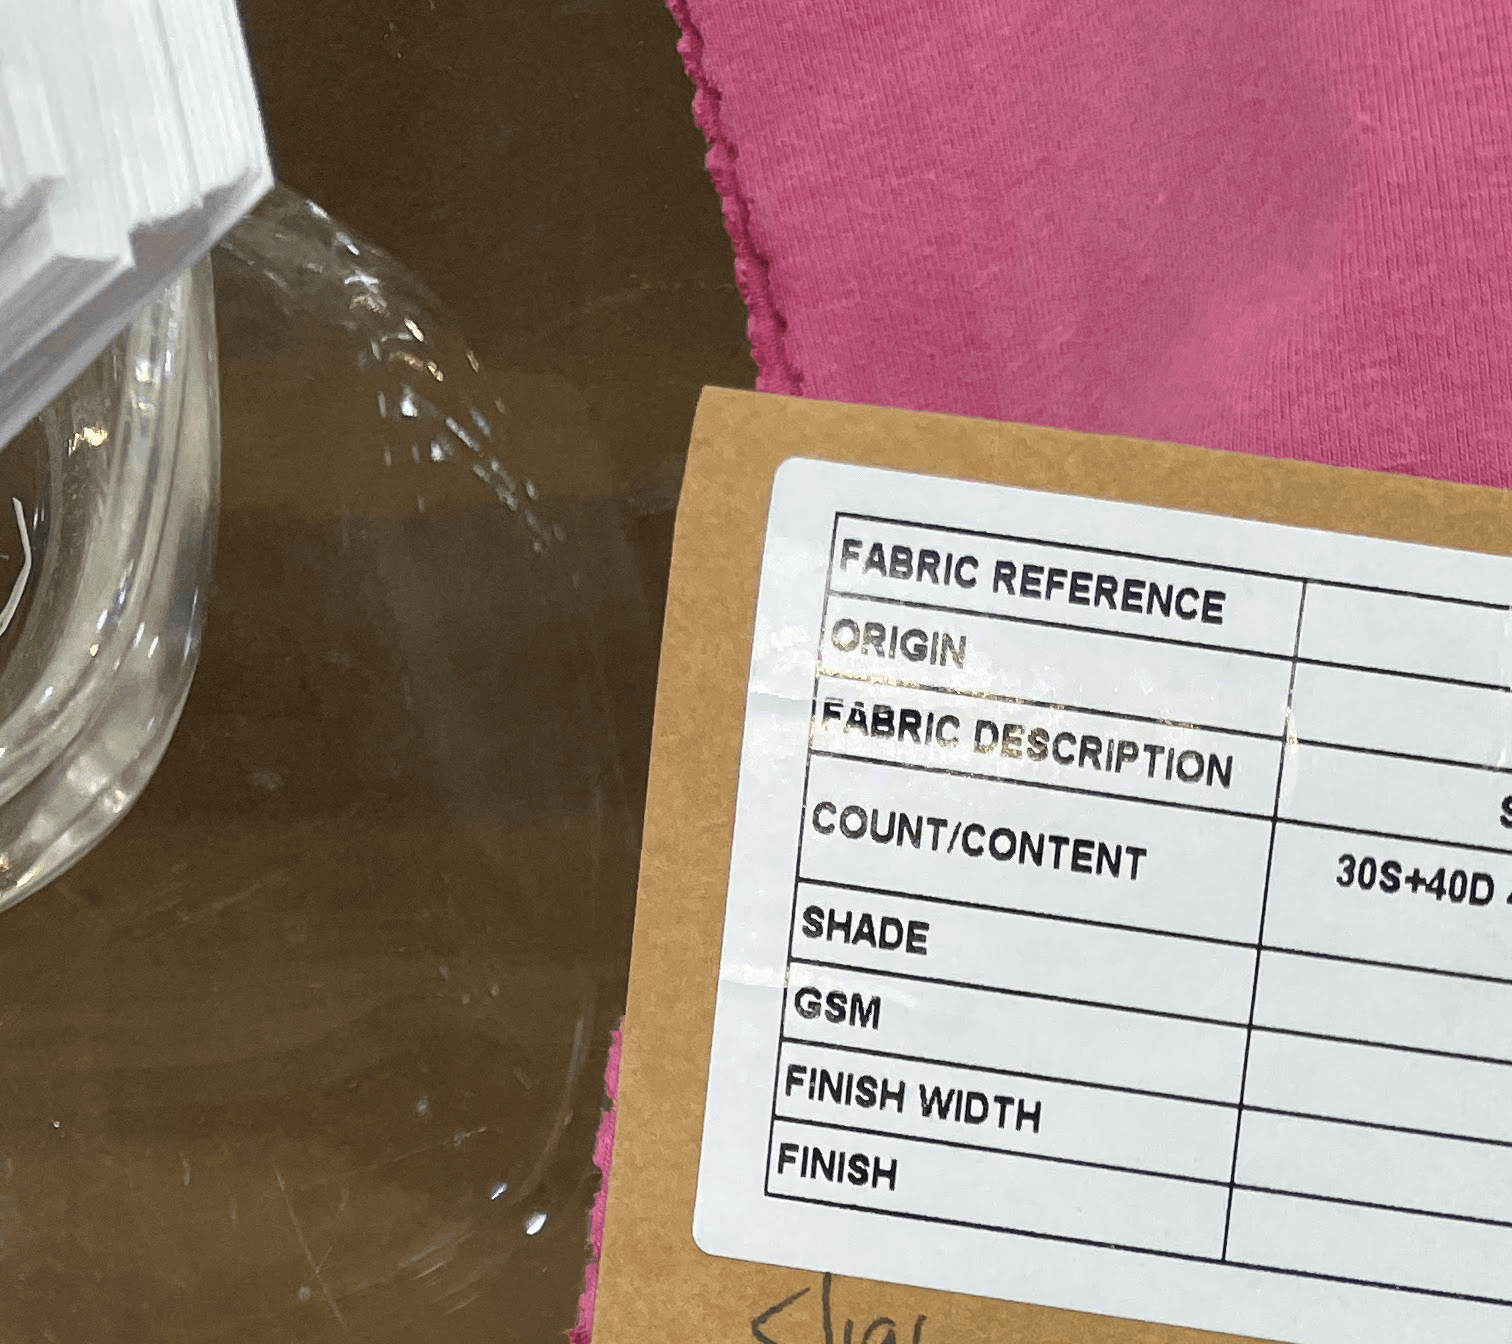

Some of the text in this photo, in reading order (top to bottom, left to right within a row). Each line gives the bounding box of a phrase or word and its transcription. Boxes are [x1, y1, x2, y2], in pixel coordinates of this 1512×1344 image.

[841, 539, 1226, 625] FABRIC REFERENCE
[832, 619, 966, 668] ORIGIN
[823, 701, 1233, 788] FABRIC DESCRIPTION
[813, 802, 1147, 880] COUNT/CONTENT
[1337, 854, 1494, 906] 30S+40D
[802, 905, 929, 955] SHADE
[795, 987, 881, 1029] GSM
[786, 1064, 1041, 1133] FINISH WIDTH
[778, 1143, 897, 1191] FINISH
